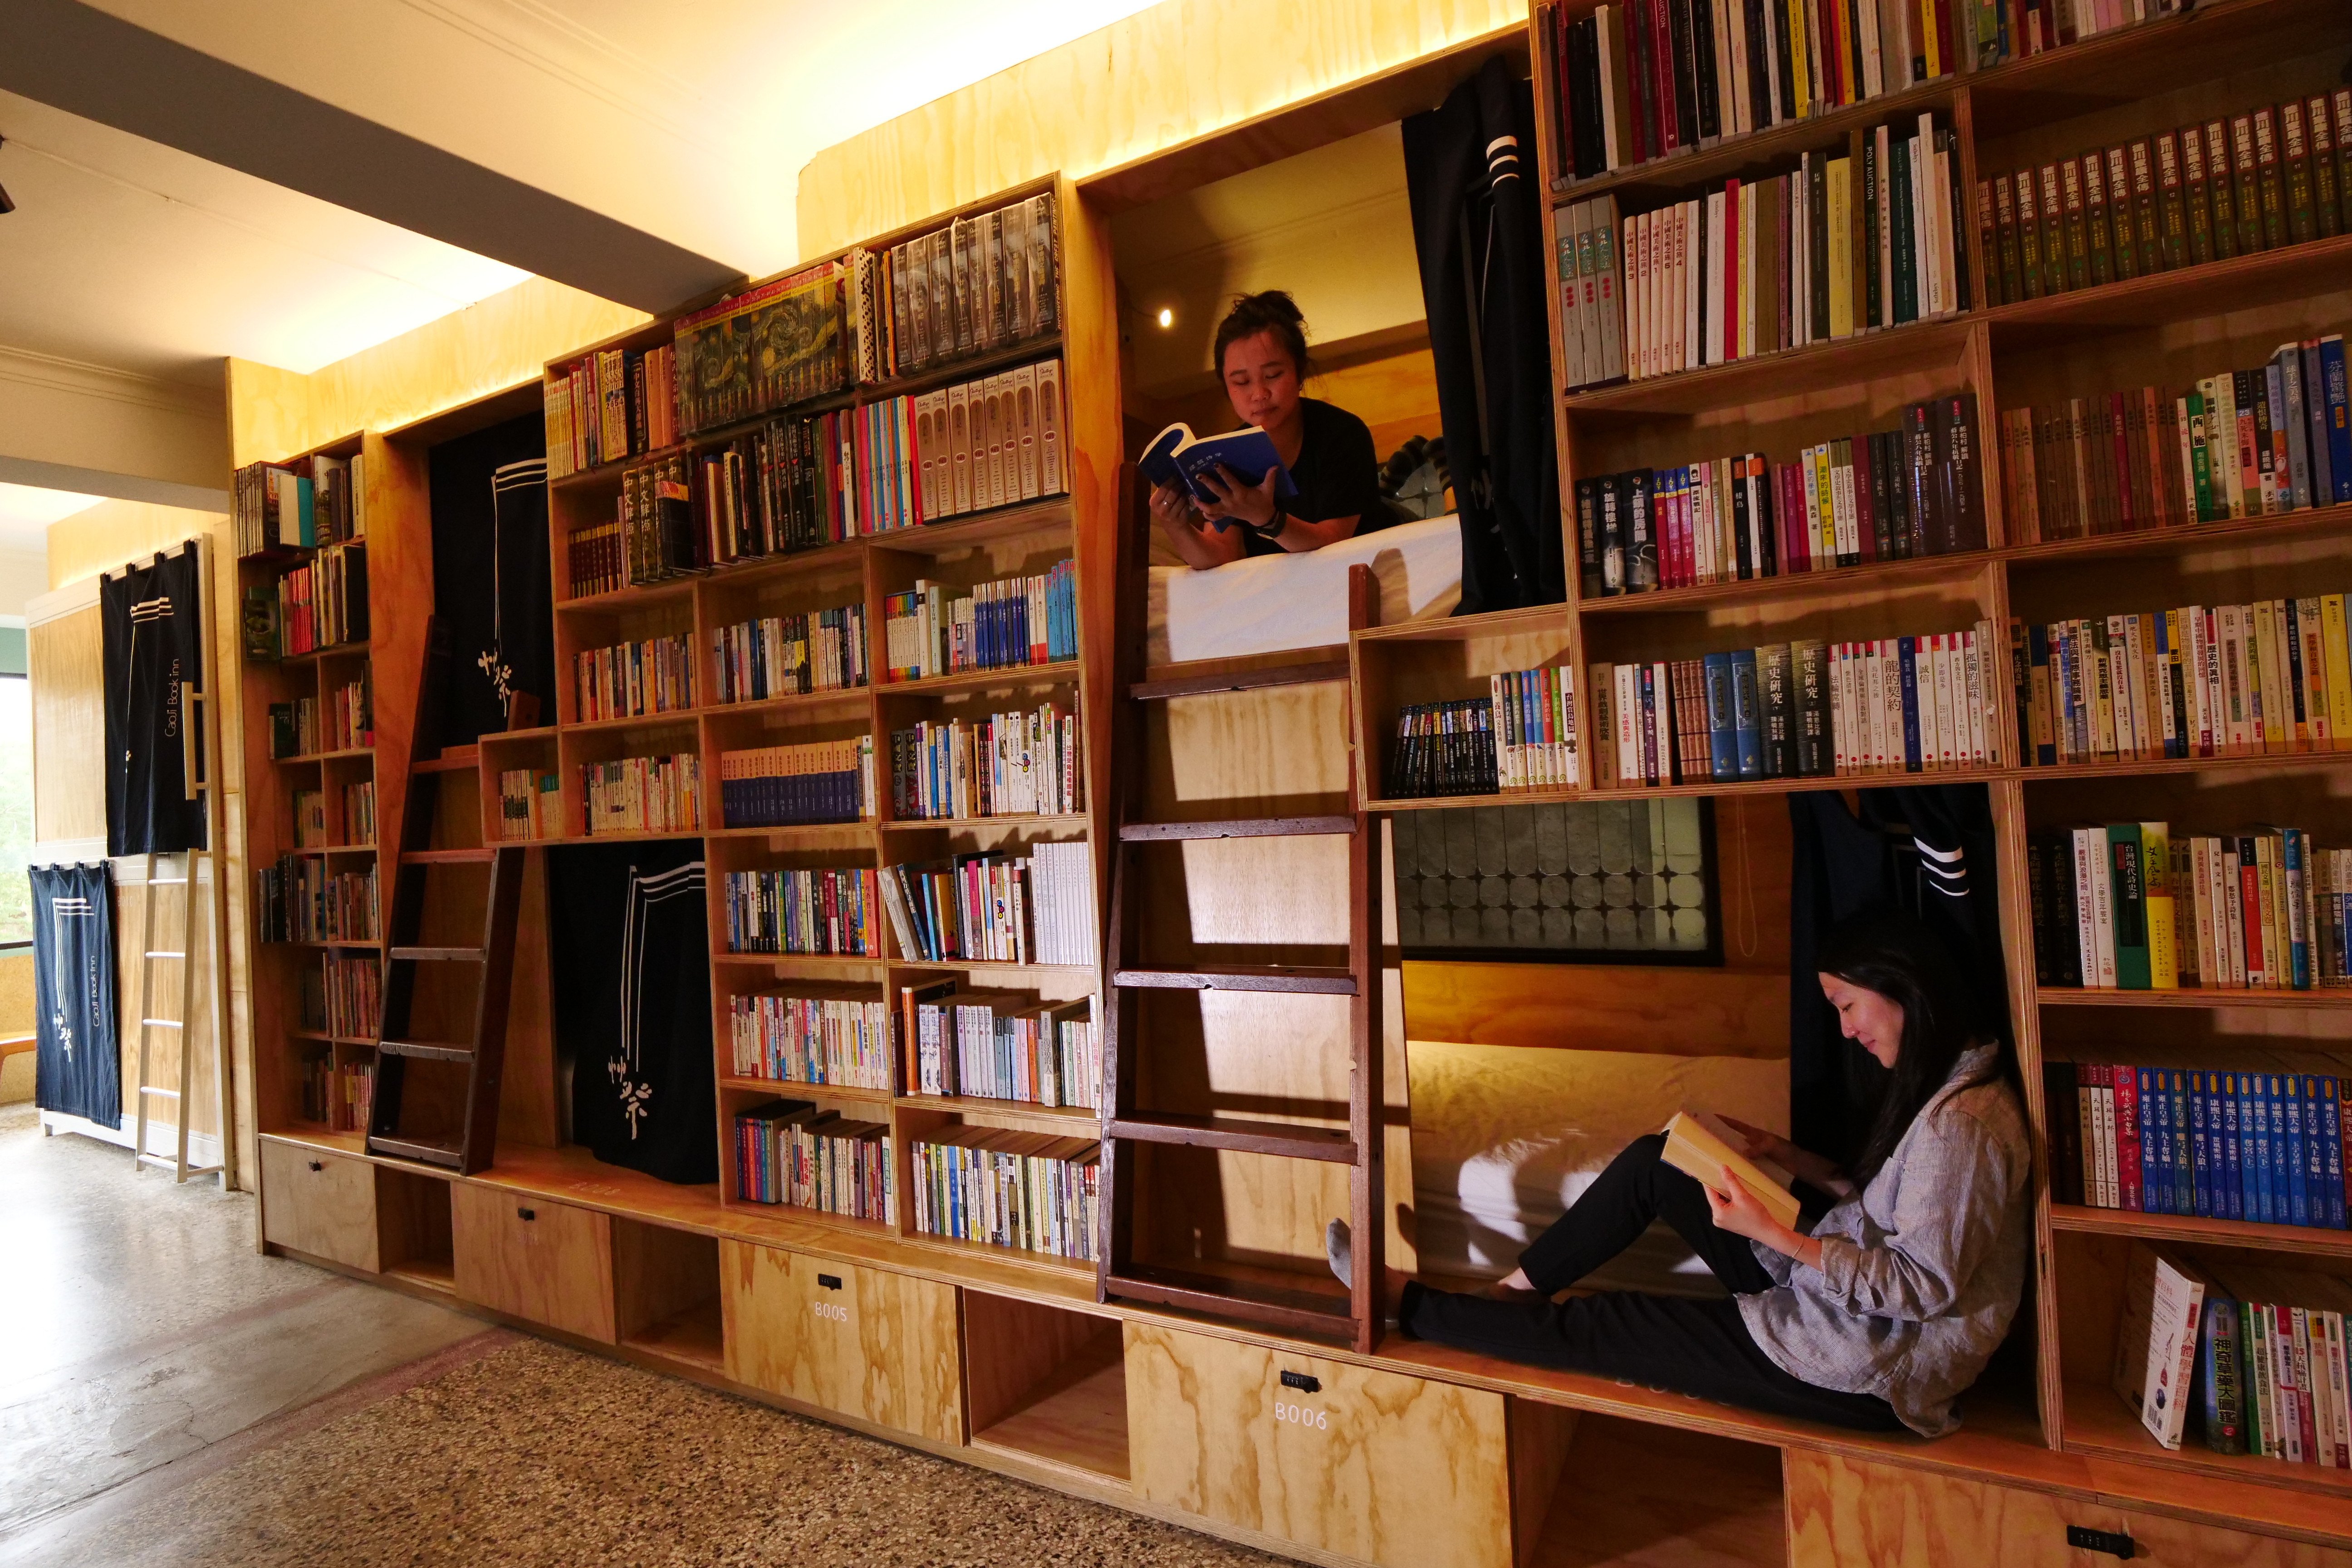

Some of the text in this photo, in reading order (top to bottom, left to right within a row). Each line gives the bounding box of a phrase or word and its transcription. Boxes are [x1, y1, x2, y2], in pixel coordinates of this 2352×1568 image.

[168, 658, 179, 677] inn
[1769, 654, 1783, 704] 歷史研究
[1803, 649, 1818, 699] 歷史研究
[1885, 660, 1901, 711] 龍的契約
[1919, 665, 1930, 684] 誠信
[1966, 653, 1980, 699] 孤獨的滋味
[167, 678, 178, 705] Book
[2125, 845, 2137, 899] 台灣現代詩史論
[2228, 886, 2237, 920] 鄭愁予詩集
[815, 1302, 847, 1322] B005
[2213, 1338, 2236, 1424] 神奇草藥大圖鑑
[1275, 1402, 1327, 1430] B006
